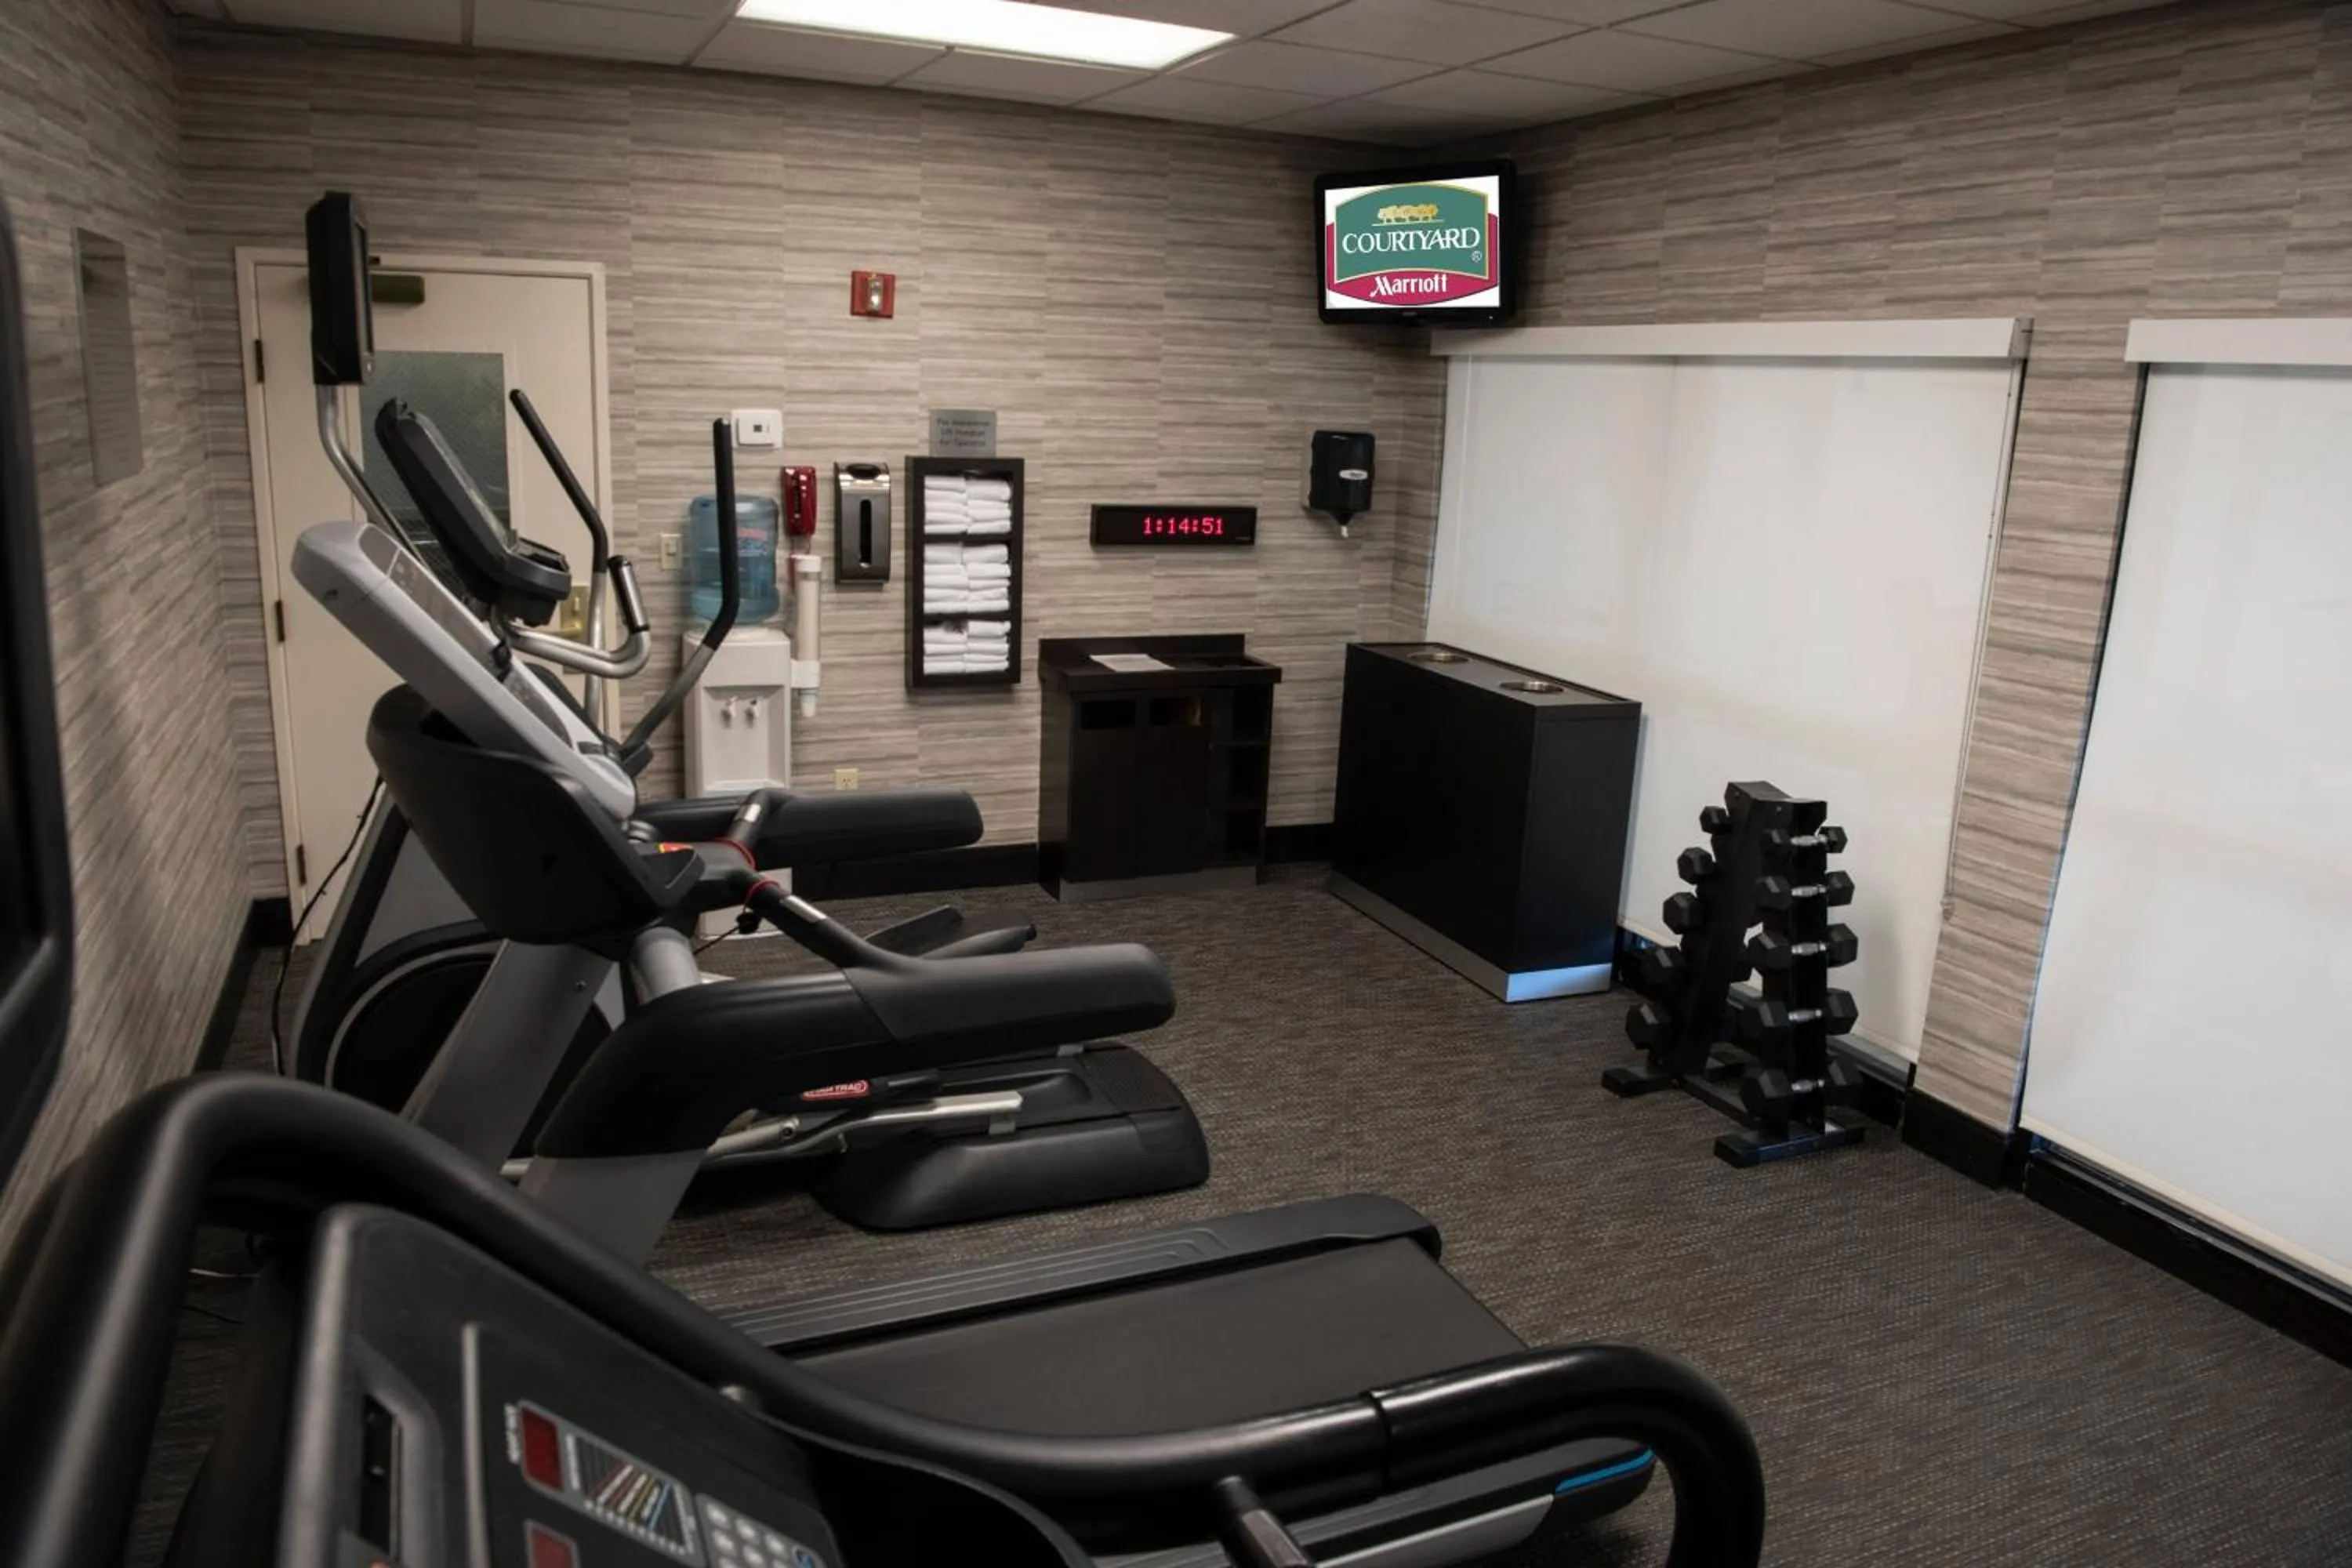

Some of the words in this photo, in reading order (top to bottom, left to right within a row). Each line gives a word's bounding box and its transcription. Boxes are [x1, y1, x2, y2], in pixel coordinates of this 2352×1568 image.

[1342, 227, 1480, 253] COURTYARD
[1370, 274, 1448, 297] Marriott
[1142, 516, 1224, 535] 1:14:51
